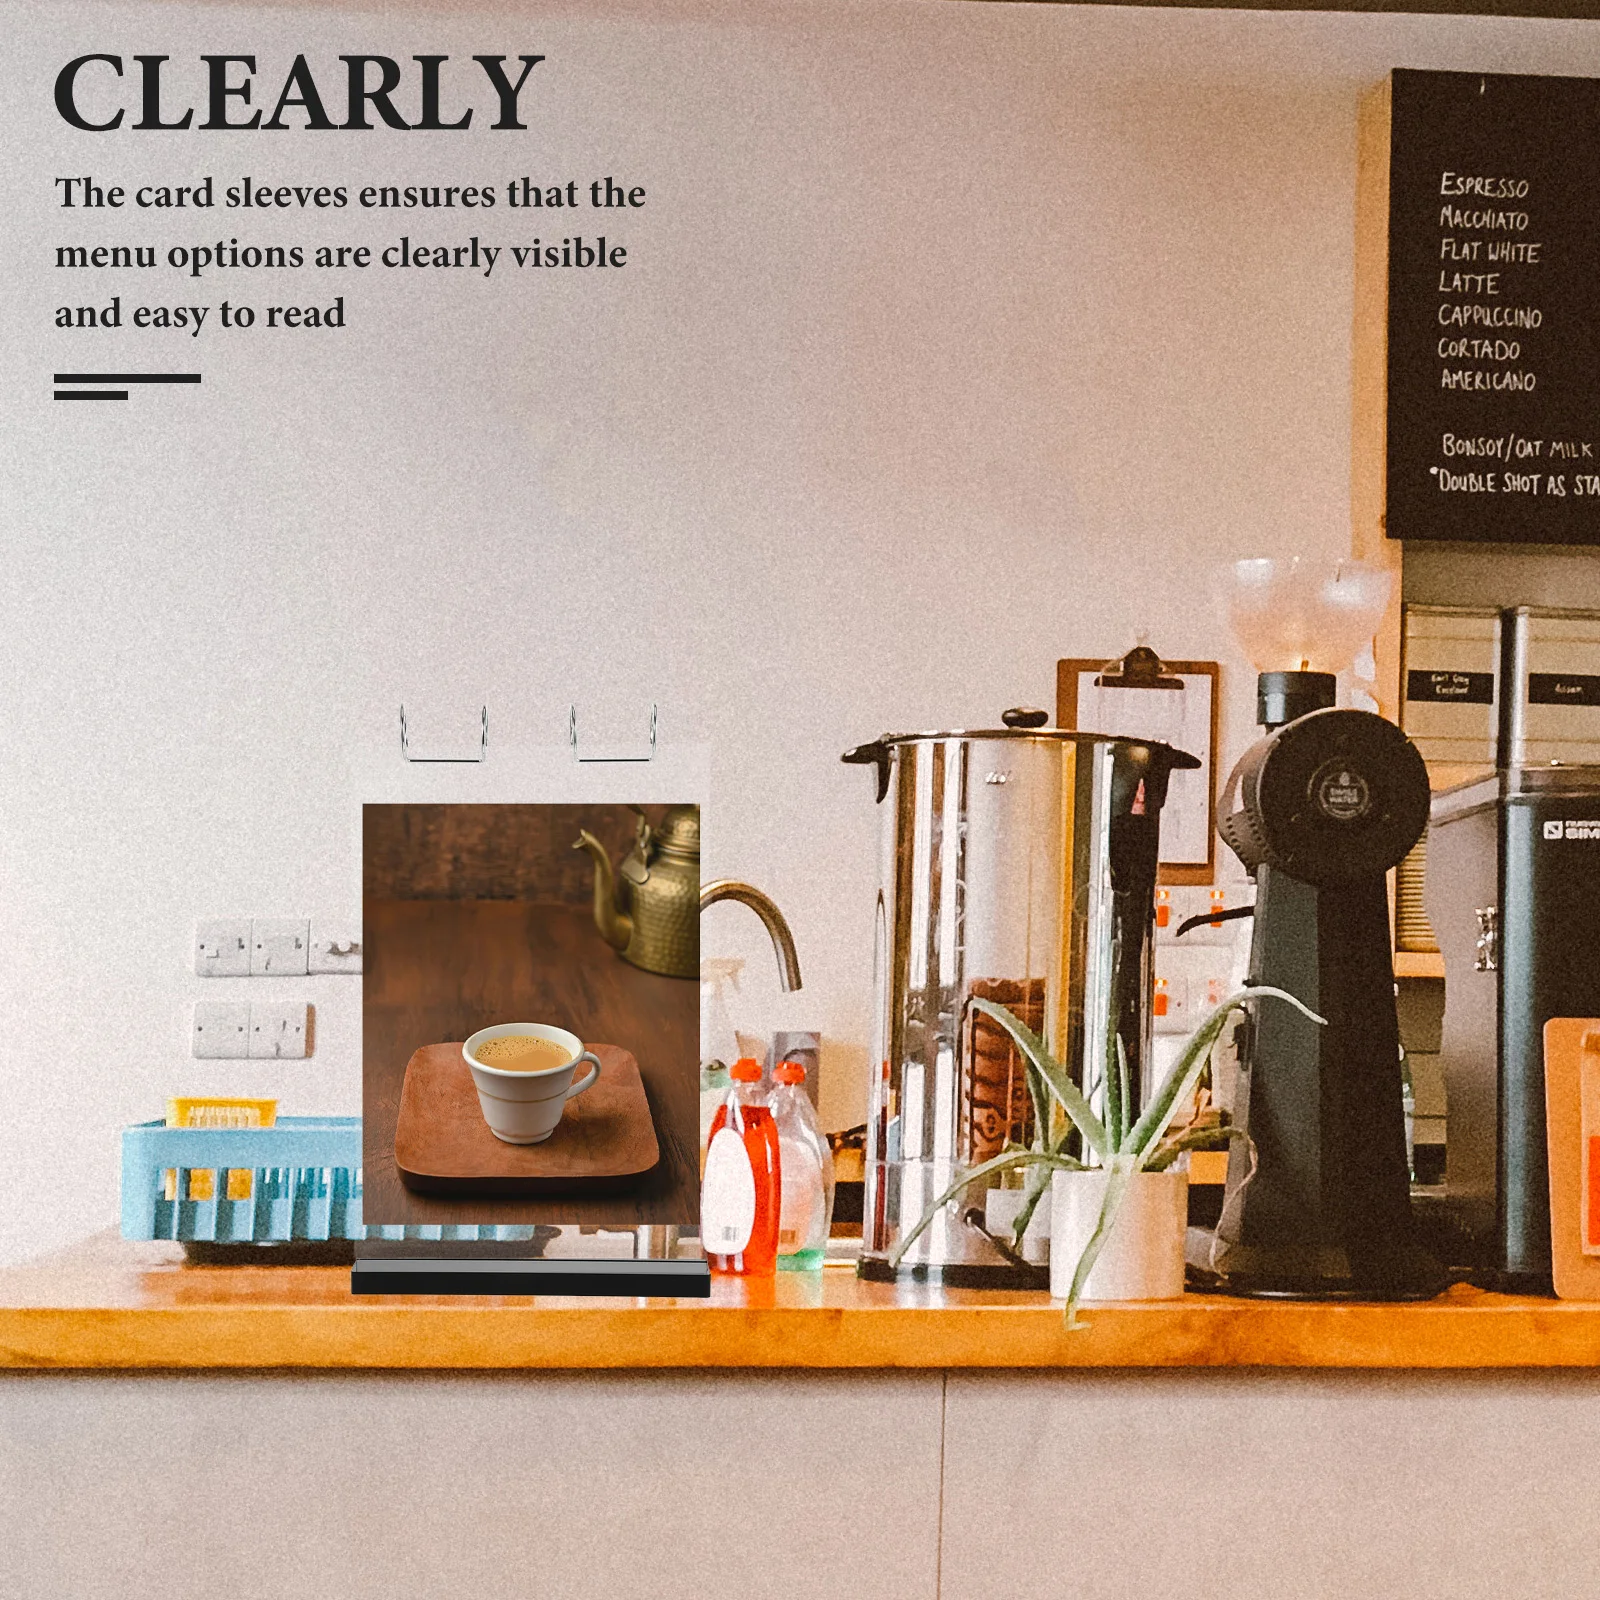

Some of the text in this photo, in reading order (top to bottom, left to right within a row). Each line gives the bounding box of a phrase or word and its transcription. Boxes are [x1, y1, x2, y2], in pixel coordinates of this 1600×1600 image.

[1440, 171, 1529, 199] ESPRESSO
[1440, 204, 1529, 231] MACCHIATO
[1440, 238, 1541, 264] FLAT WHITE
[1438, 270, 1500, 295] LATTE
[1438, 303, 1543, 329] CAPPUCCINO
[1438, 337, 1521, 361] CORTADO
[1441, 368, 1536, 392] AMERICANO
[1549, 441, 1593, 459] MILK
[1502, 472, 1541, 496] SHOT
[1547, 475, 1567, 497] AS
